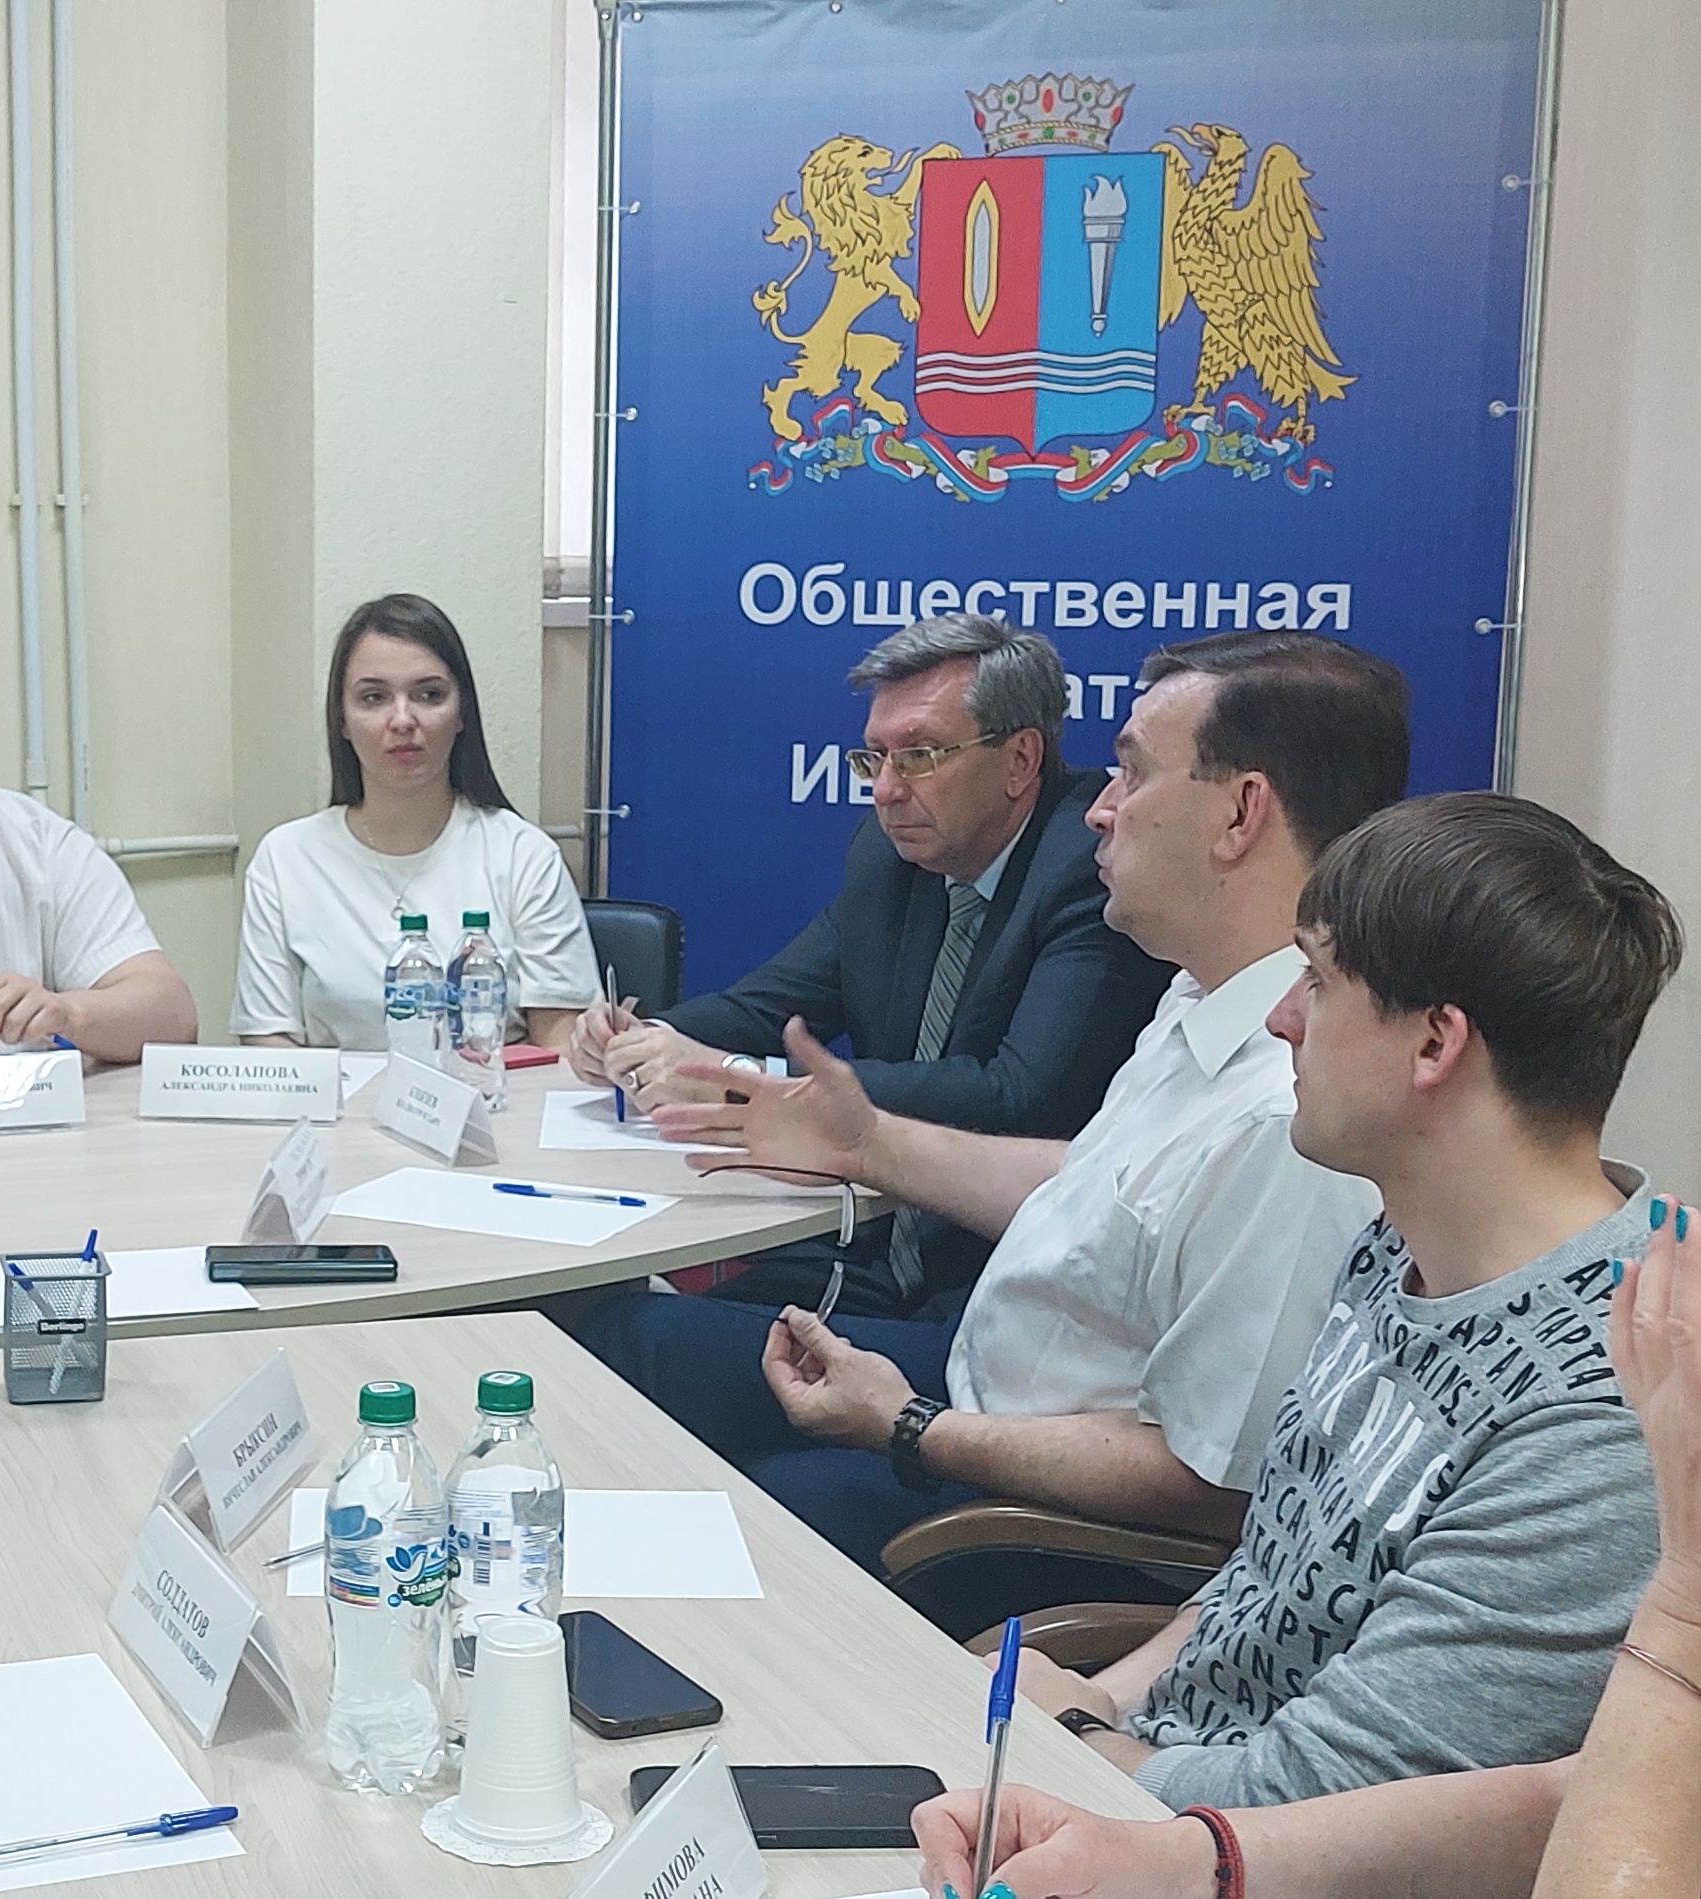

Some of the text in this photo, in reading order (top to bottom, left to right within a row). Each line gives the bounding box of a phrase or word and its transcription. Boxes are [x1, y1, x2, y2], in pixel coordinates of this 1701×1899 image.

[739, 562, 1352, 630] Общественная
[160, 1080, 236, 1092] АЛЕКСАНДРА
[181, 1064, 299, 1079] КОСОЛАПОВА
[157, 1570, 210, 1638] СОЛДАТОВ
